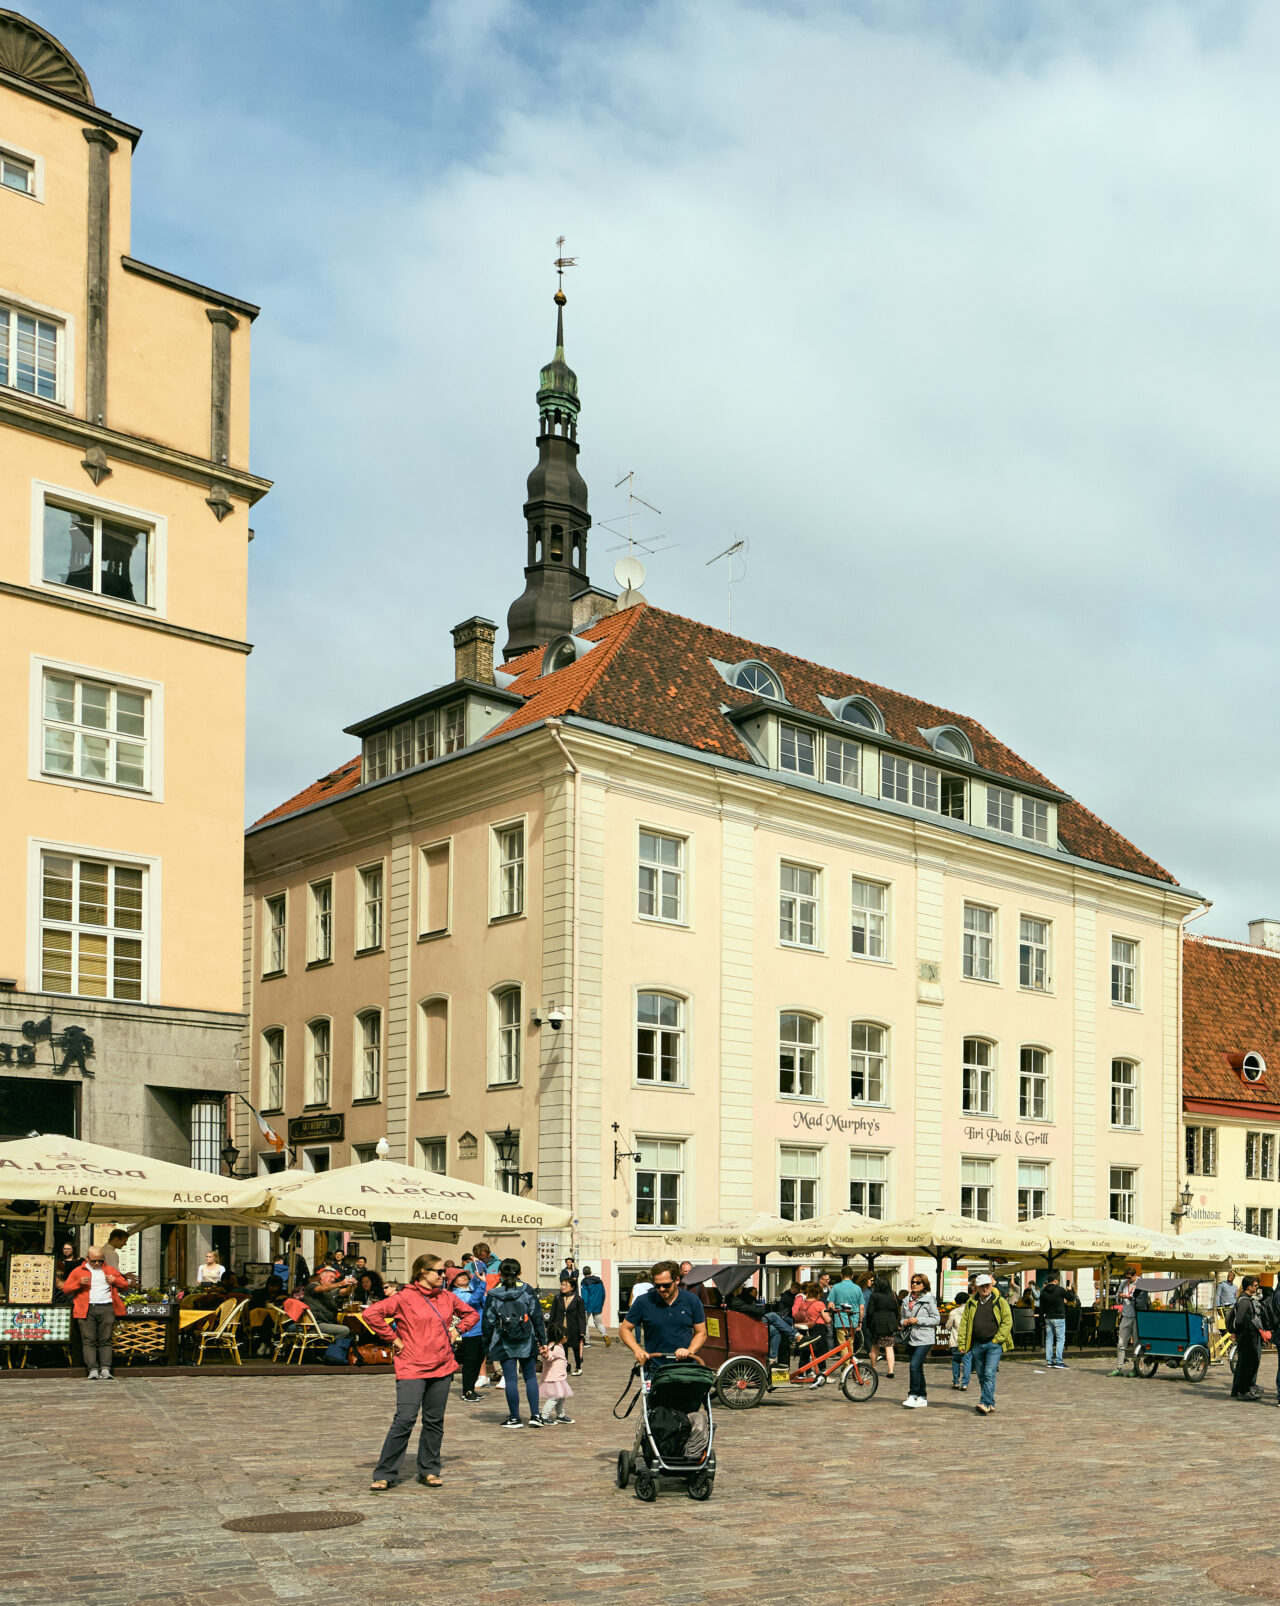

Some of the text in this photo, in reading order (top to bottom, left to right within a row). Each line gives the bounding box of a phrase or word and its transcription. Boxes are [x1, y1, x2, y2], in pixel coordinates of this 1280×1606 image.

[793, 1111, 881, 1137] Mad Murphy's
[987, 1128, 1012, 1145] Pubi
[1014, 1130, 1023, 1145] &
[1024, 1131, 1049, 1146] Grill
